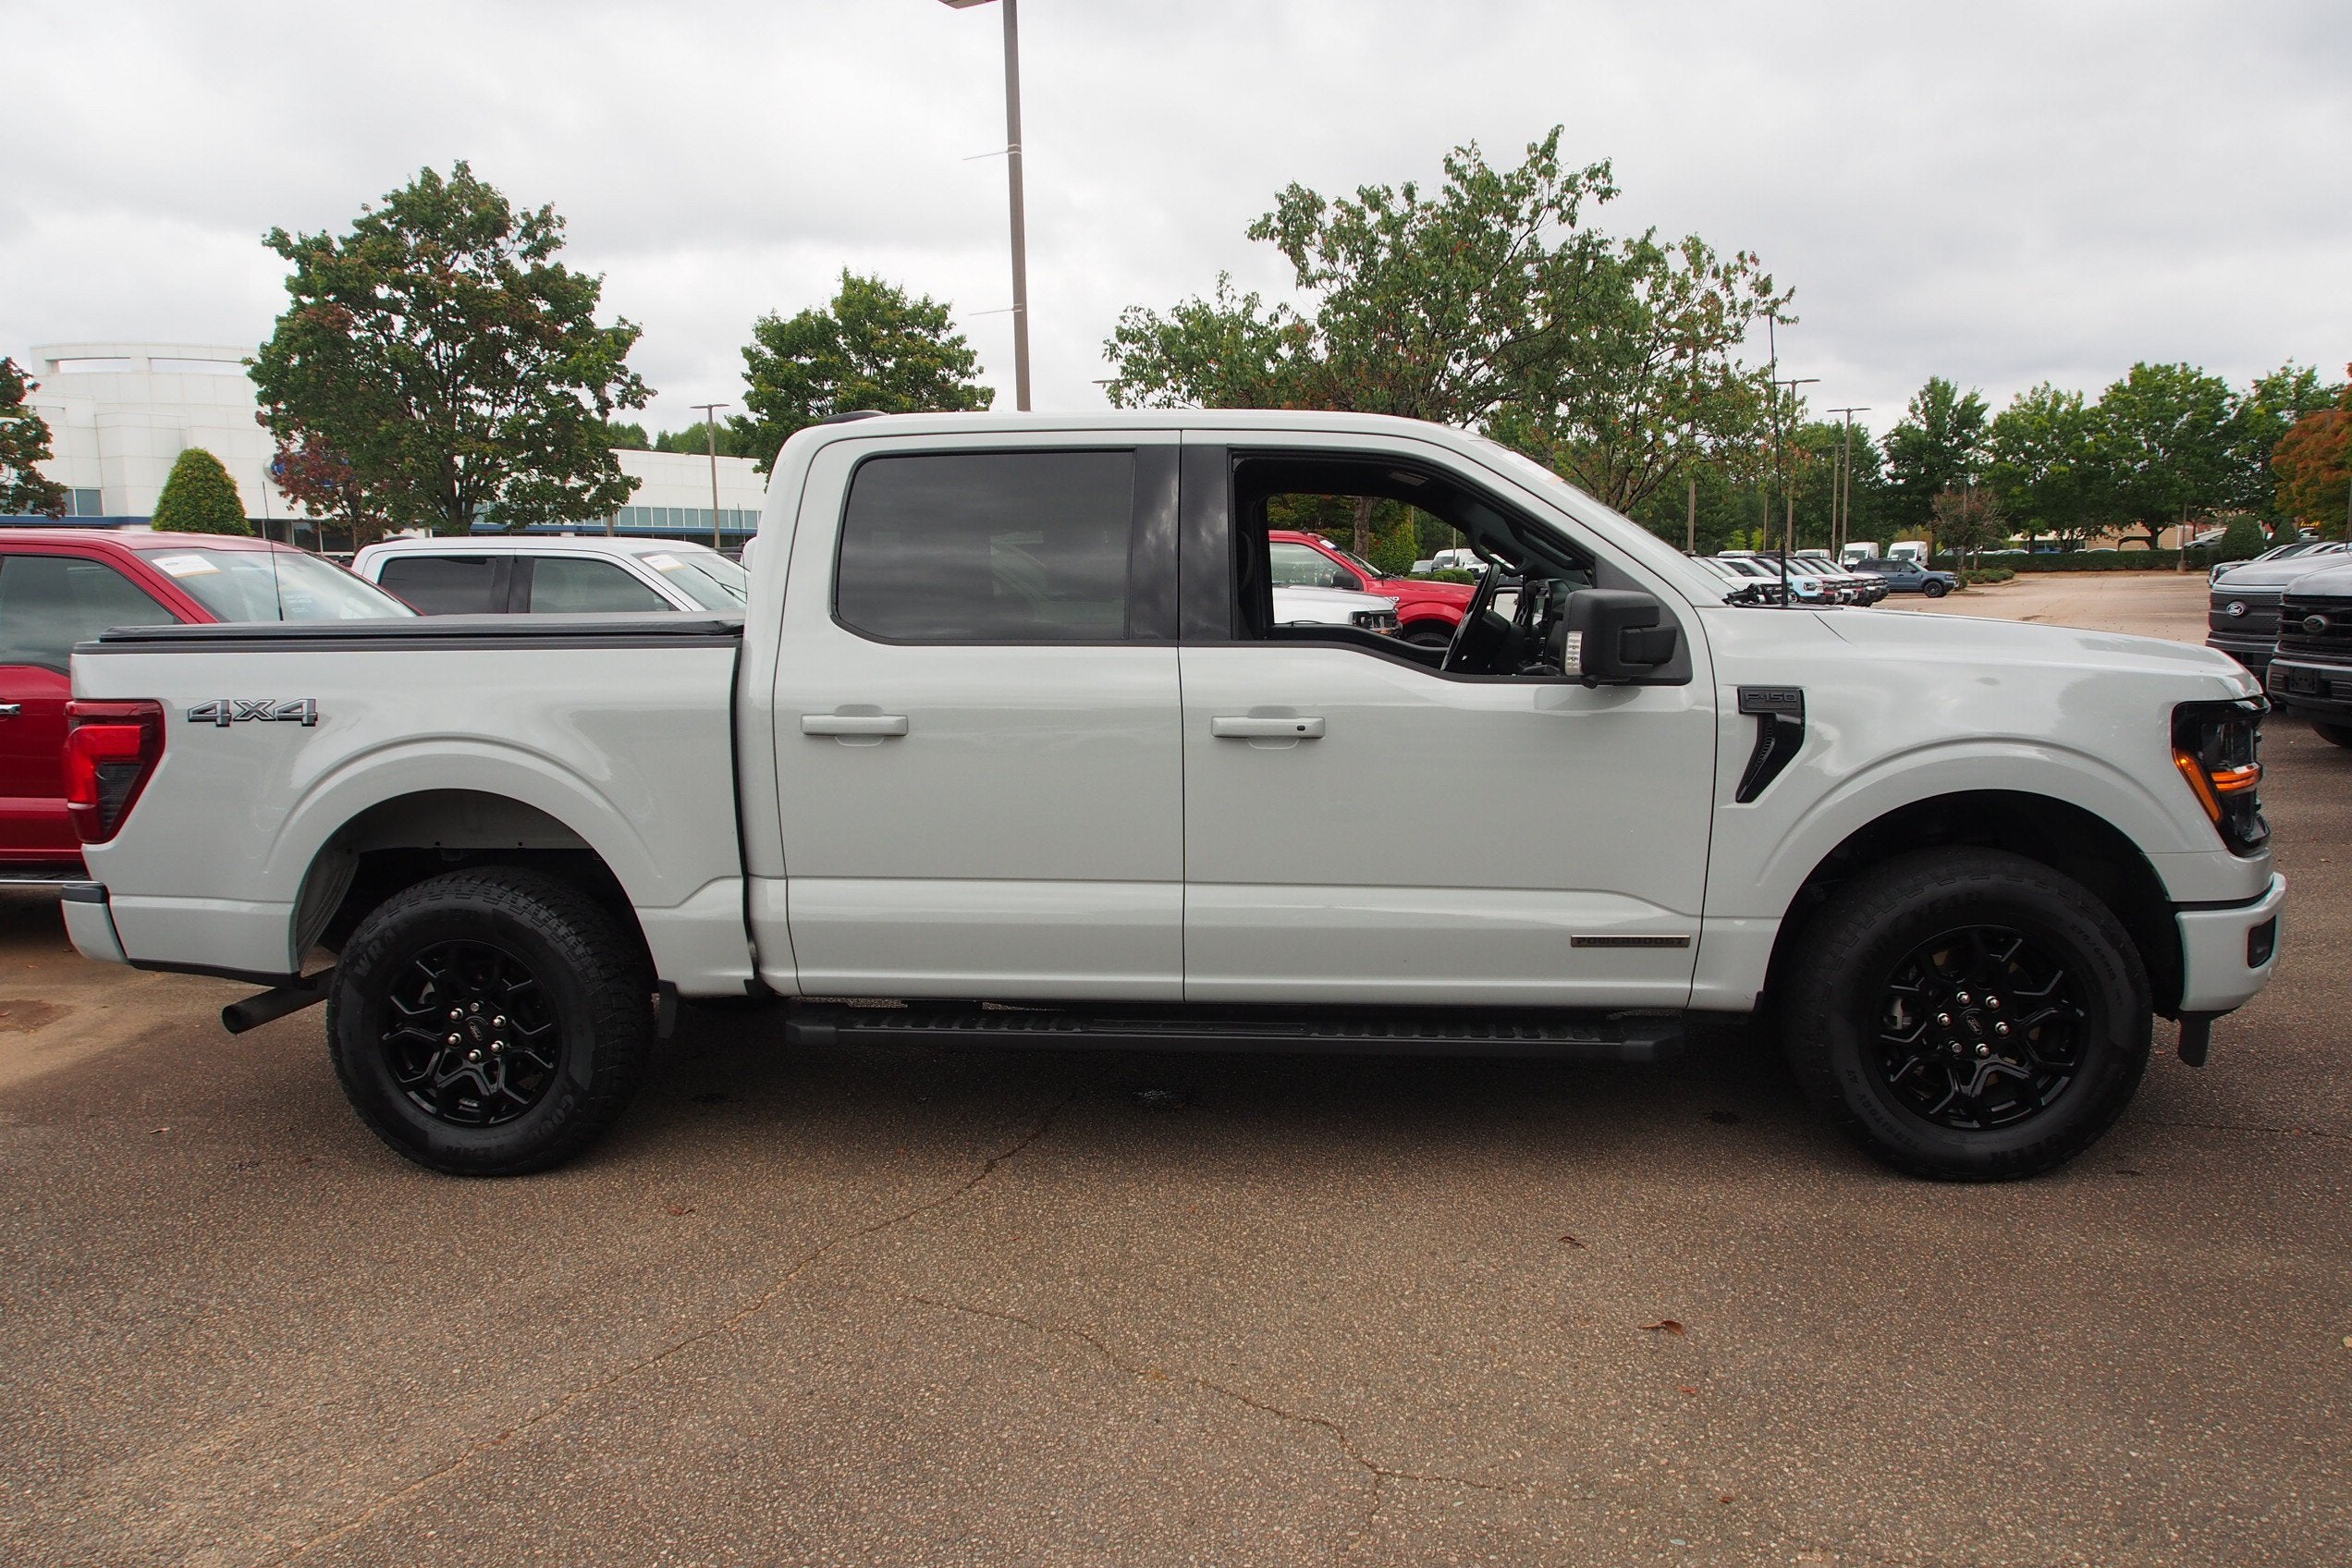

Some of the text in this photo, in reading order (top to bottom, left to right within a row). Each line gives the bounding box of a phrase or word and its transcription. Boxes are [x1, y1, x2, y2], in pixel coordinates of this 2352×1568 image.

[1744, 692, 1797, 703] F-150
[188, 699, 318, 727] 4X4
[1575, 937, 1685, 946] POWERBOOST
